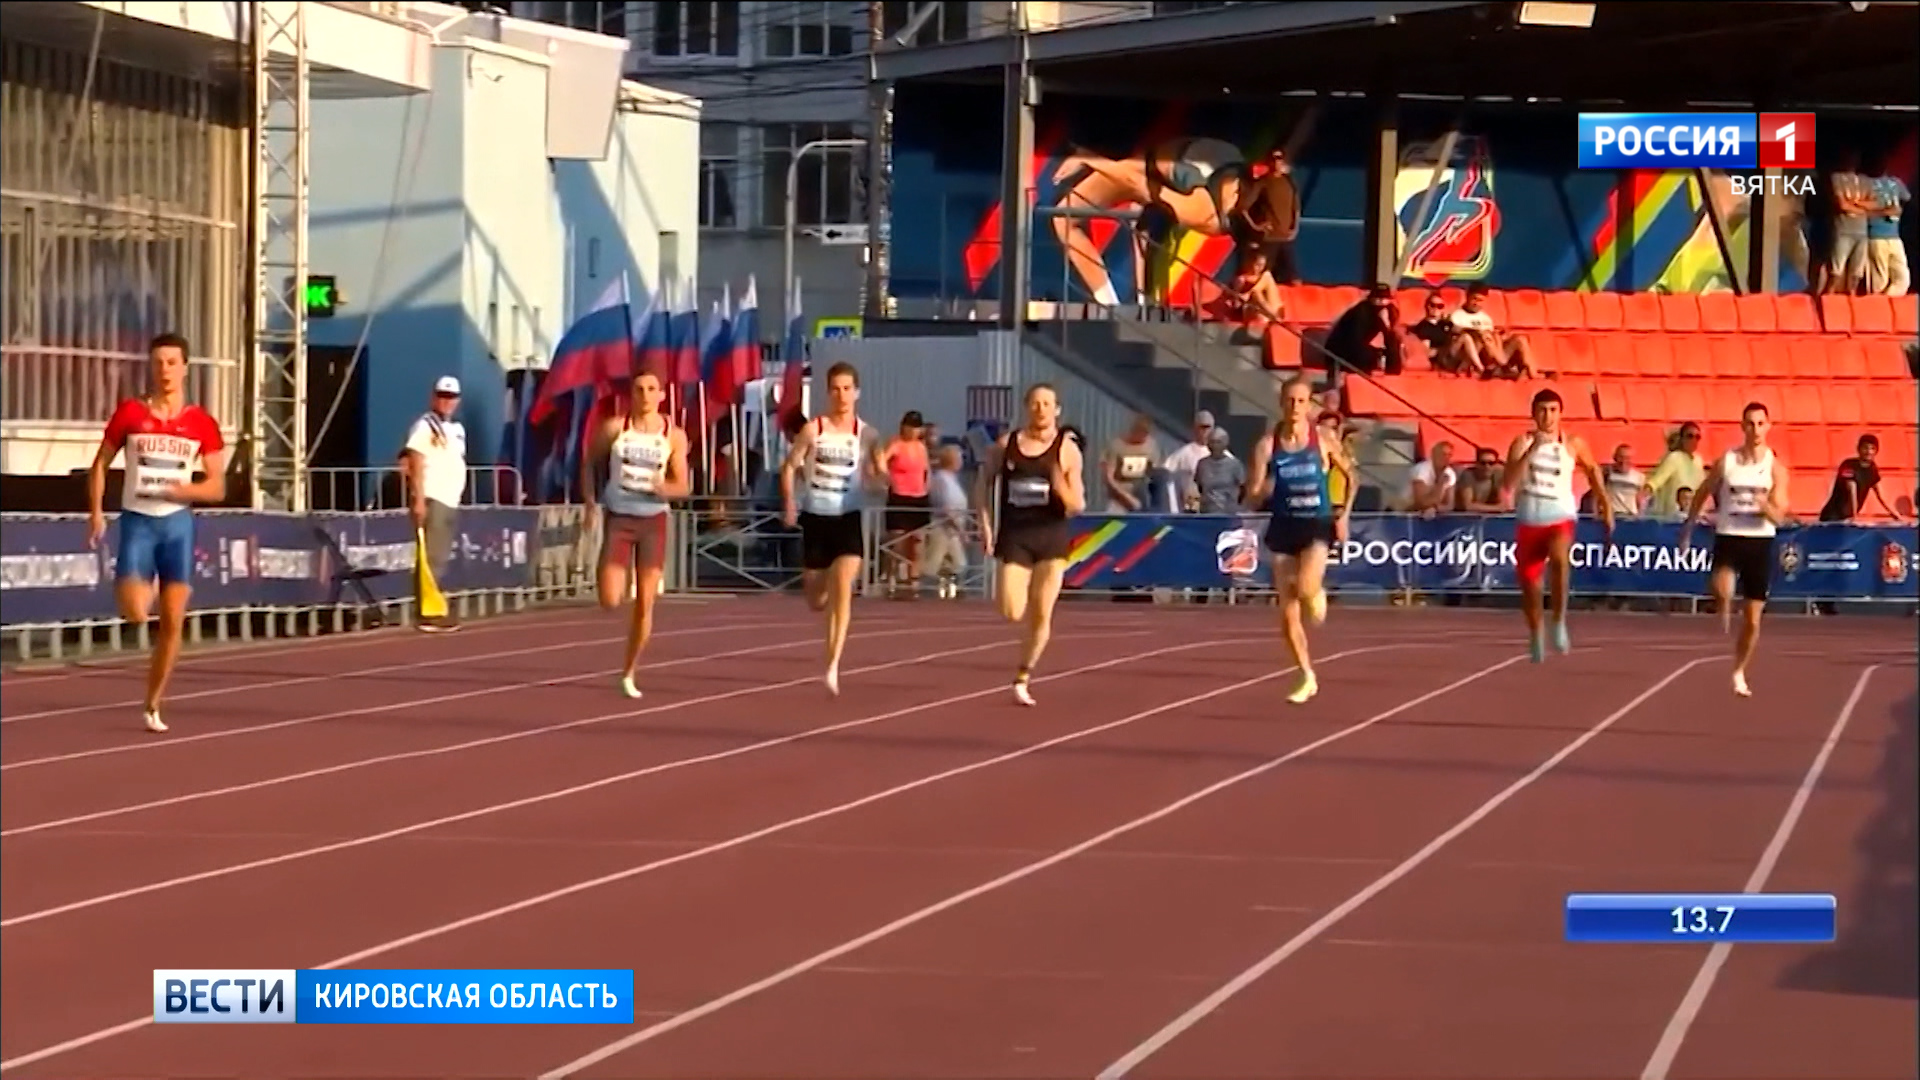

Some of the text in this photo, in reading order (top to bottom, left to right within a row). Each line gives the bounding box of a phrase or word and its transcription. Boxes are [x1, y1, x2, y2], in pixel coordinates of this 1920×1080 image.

[136, 437, 192, 458] RUSSIA
[1325, 535, 1714, 573] ЕРОССИЙСК СПАРТАКИ
